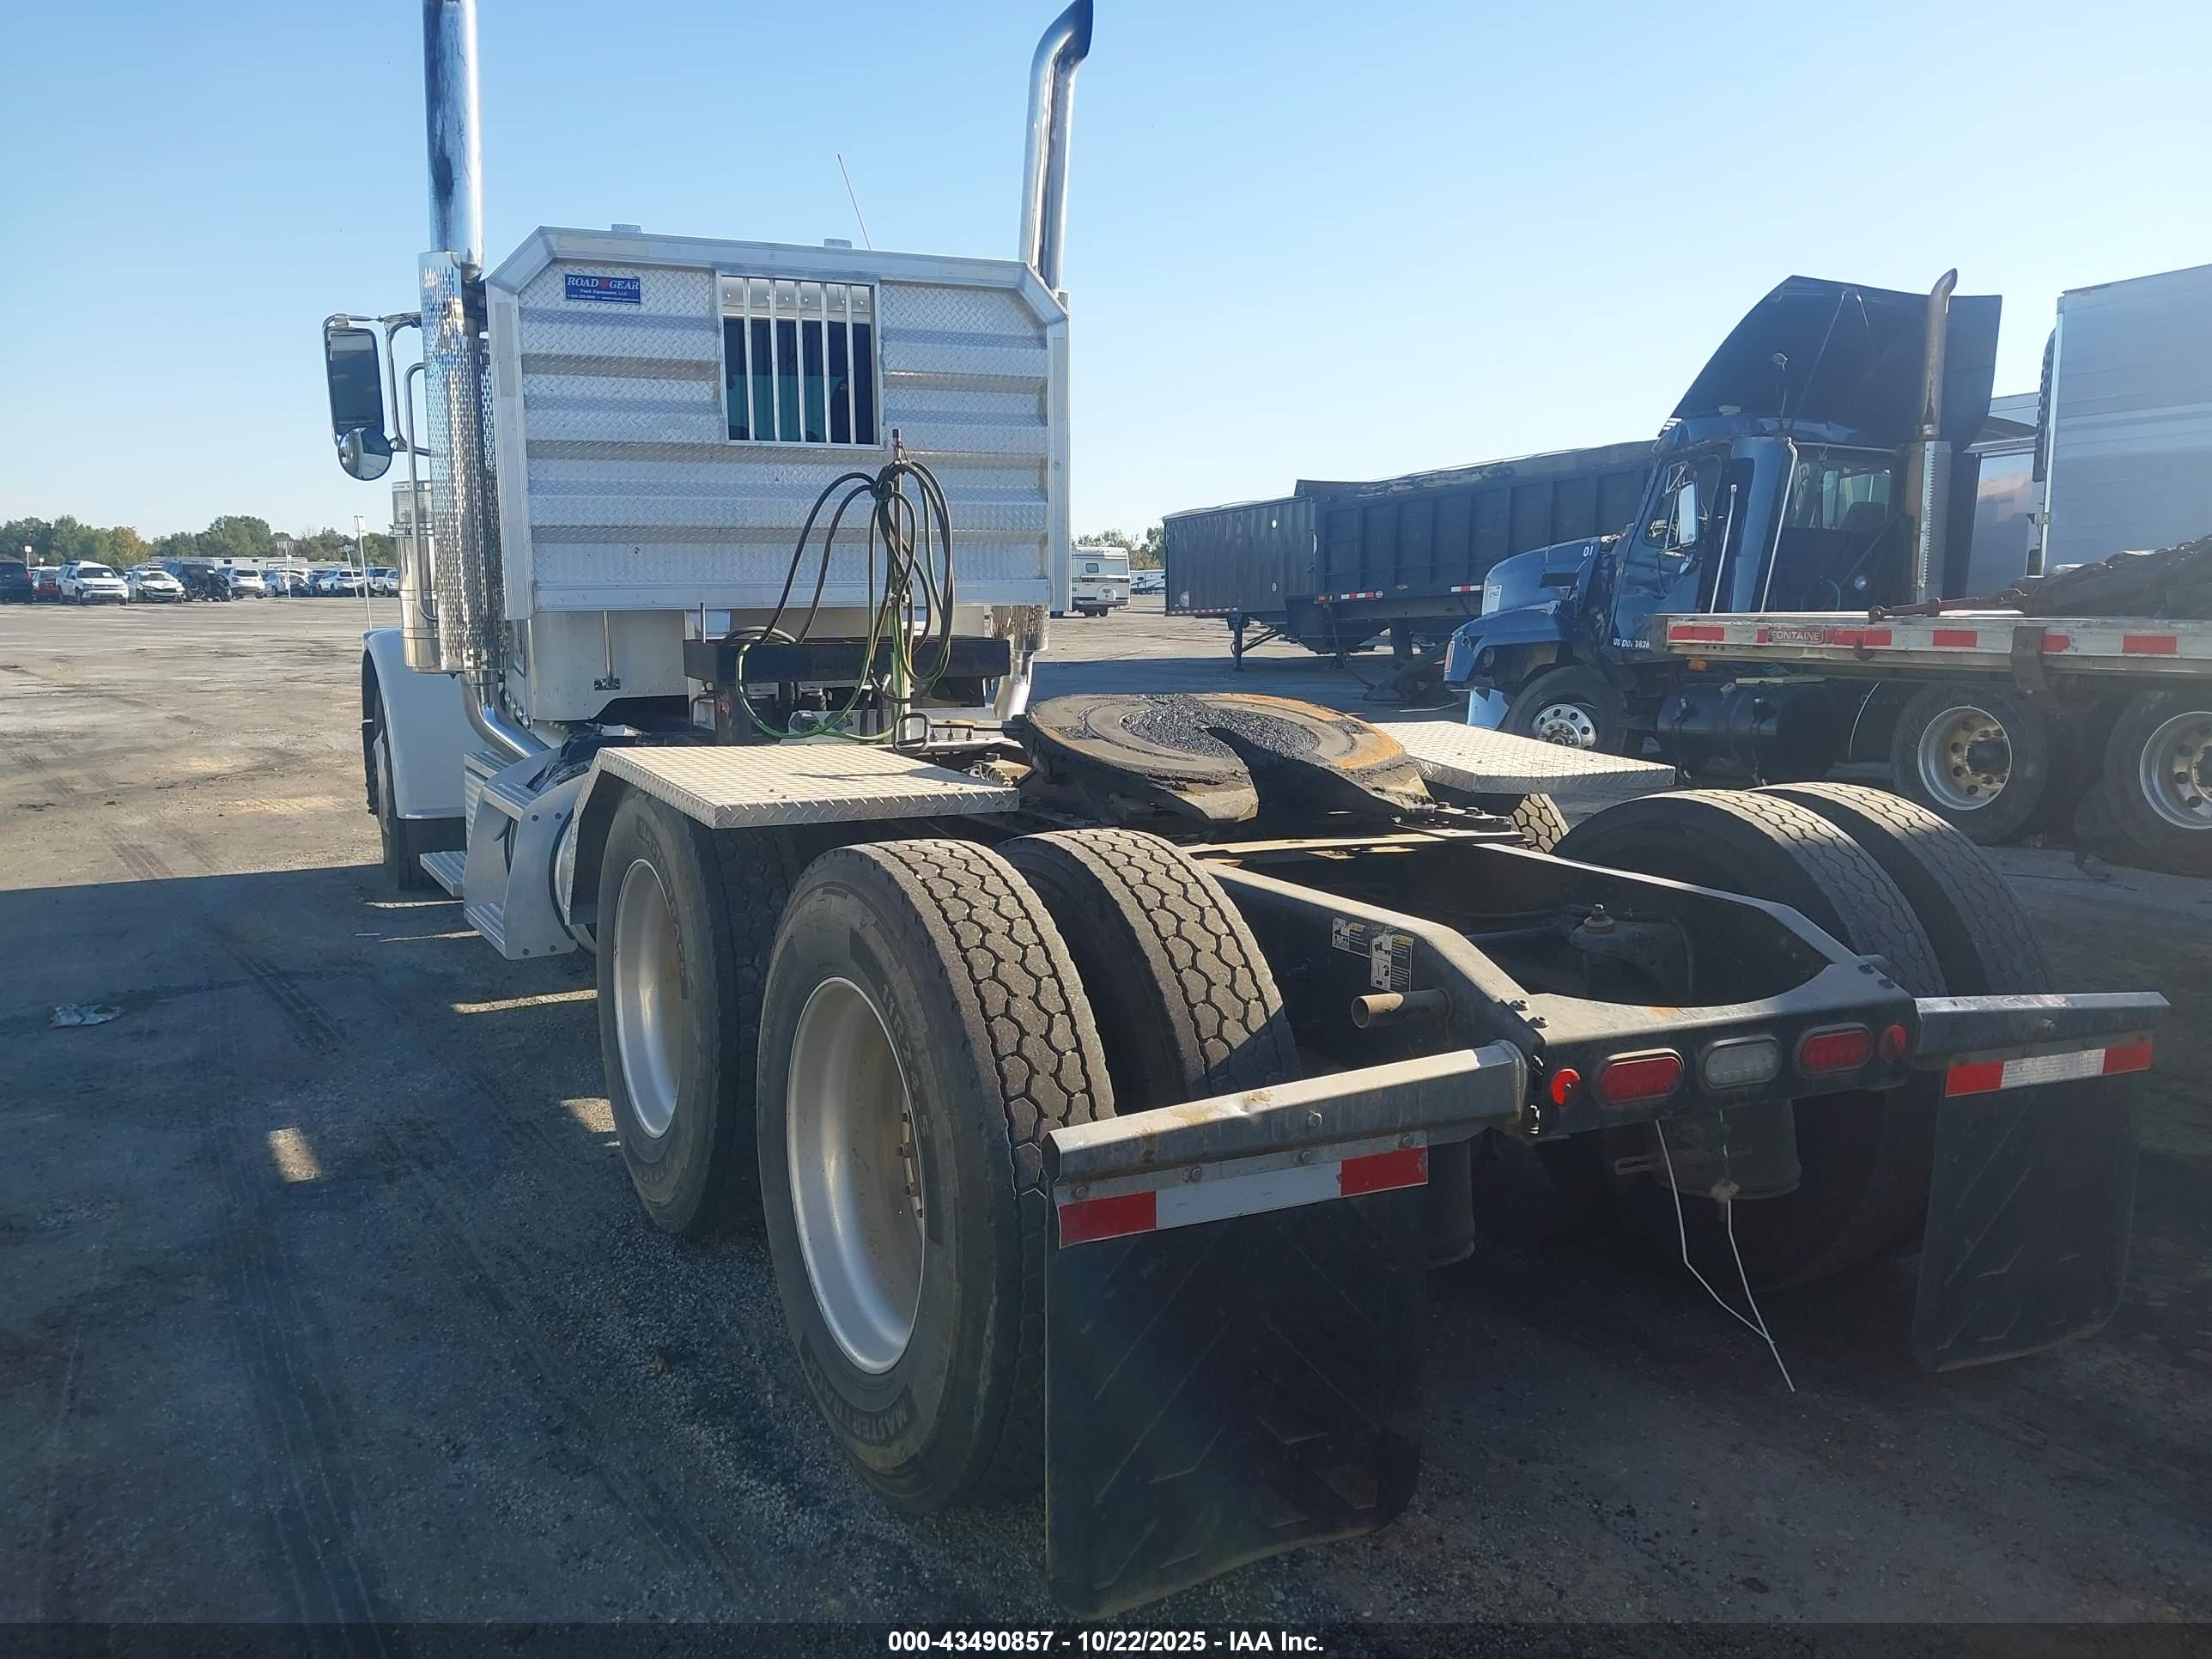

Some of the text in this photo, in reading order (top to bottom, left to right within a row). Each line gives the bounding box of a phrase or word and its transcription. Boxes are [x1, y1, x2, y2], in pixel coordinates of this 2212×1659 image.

[567, 277, 639, 290] ROAD GEAR
[1613, 637, 1621, 647] US
